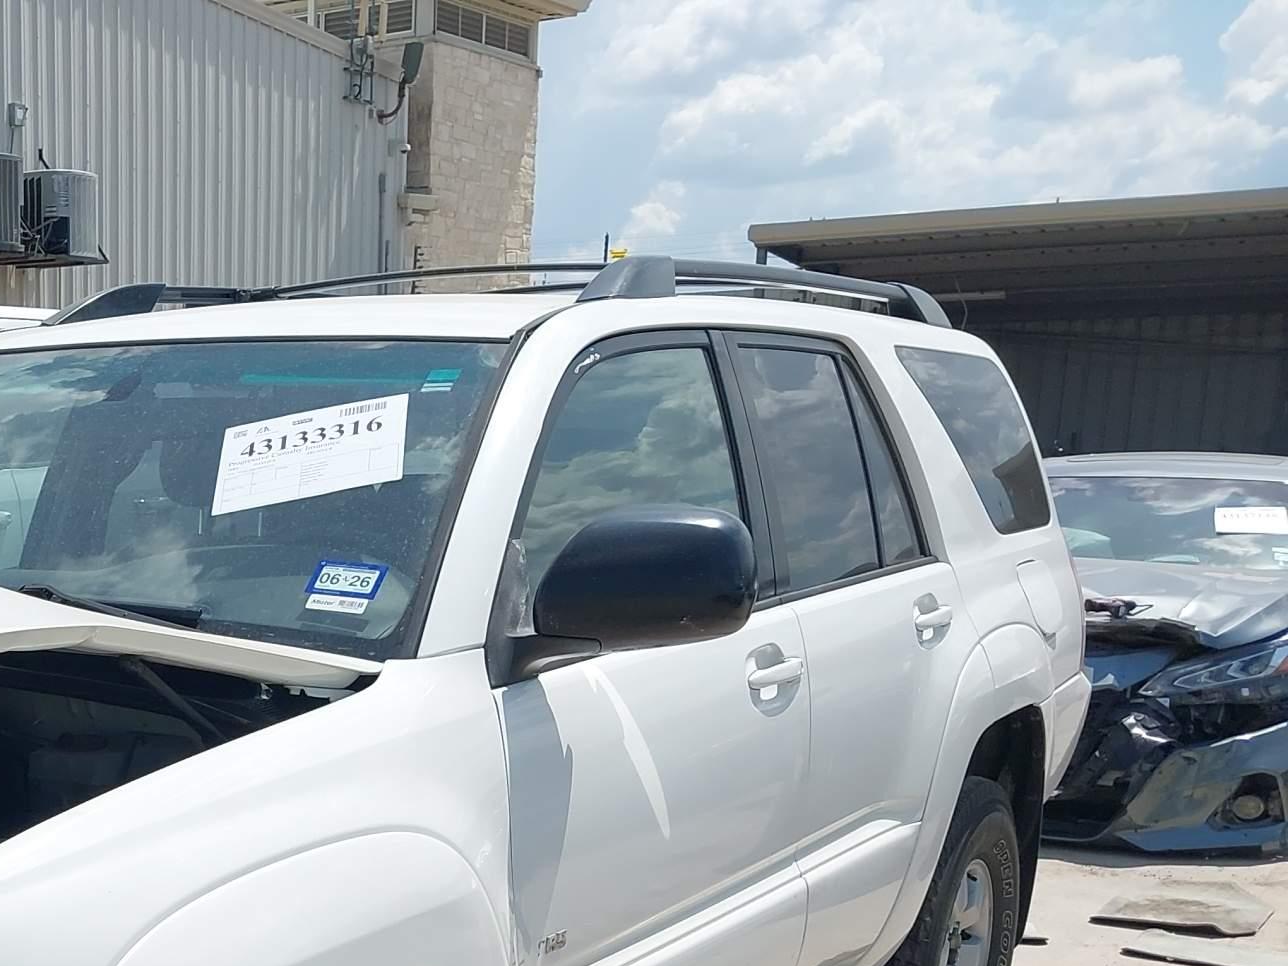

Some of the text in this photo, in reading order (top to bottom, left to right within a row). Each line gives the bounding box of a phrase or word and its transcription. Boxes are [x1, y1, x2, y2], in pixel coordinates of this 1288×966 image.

[240, 415, 383, 457] 43133316
[319, 573, 372, 588] 06 26
[993, 839, 1013, 897] OPEN
